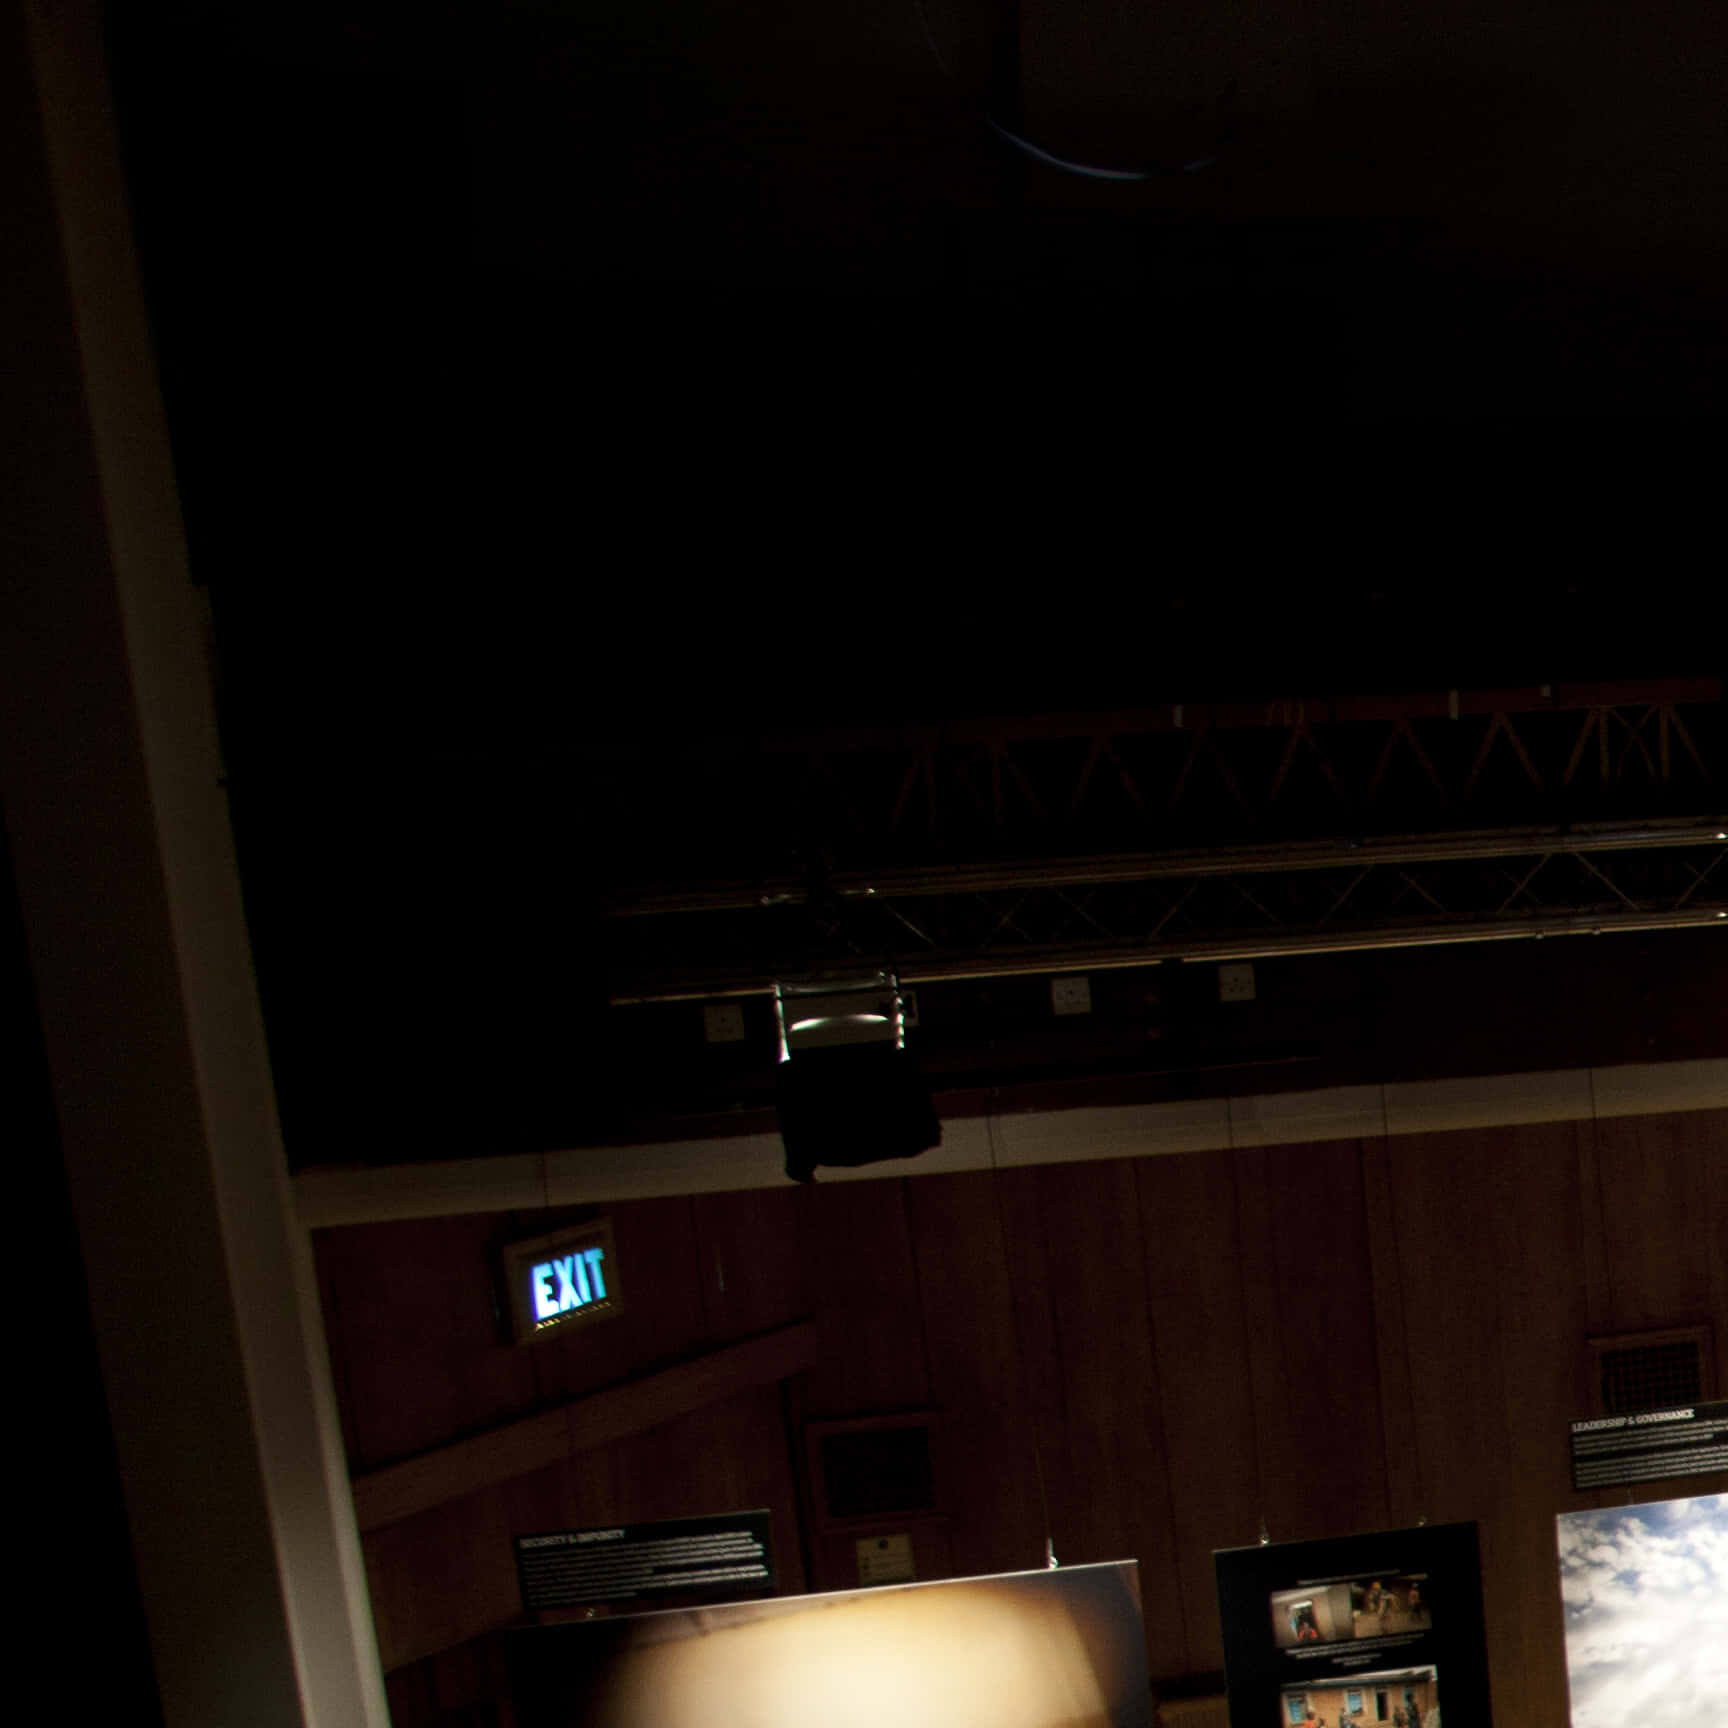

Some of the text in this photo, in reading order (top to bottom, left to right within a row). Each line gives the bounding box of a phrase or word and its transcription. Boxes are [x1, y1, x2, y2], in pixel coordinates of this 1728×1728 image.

[531, 1248, 606, 1321] EXIT
[1572, 1416, 1626, 1432] LEADERSHIP
[1636, 1408, 1695, 1424] GOVERNANCE
